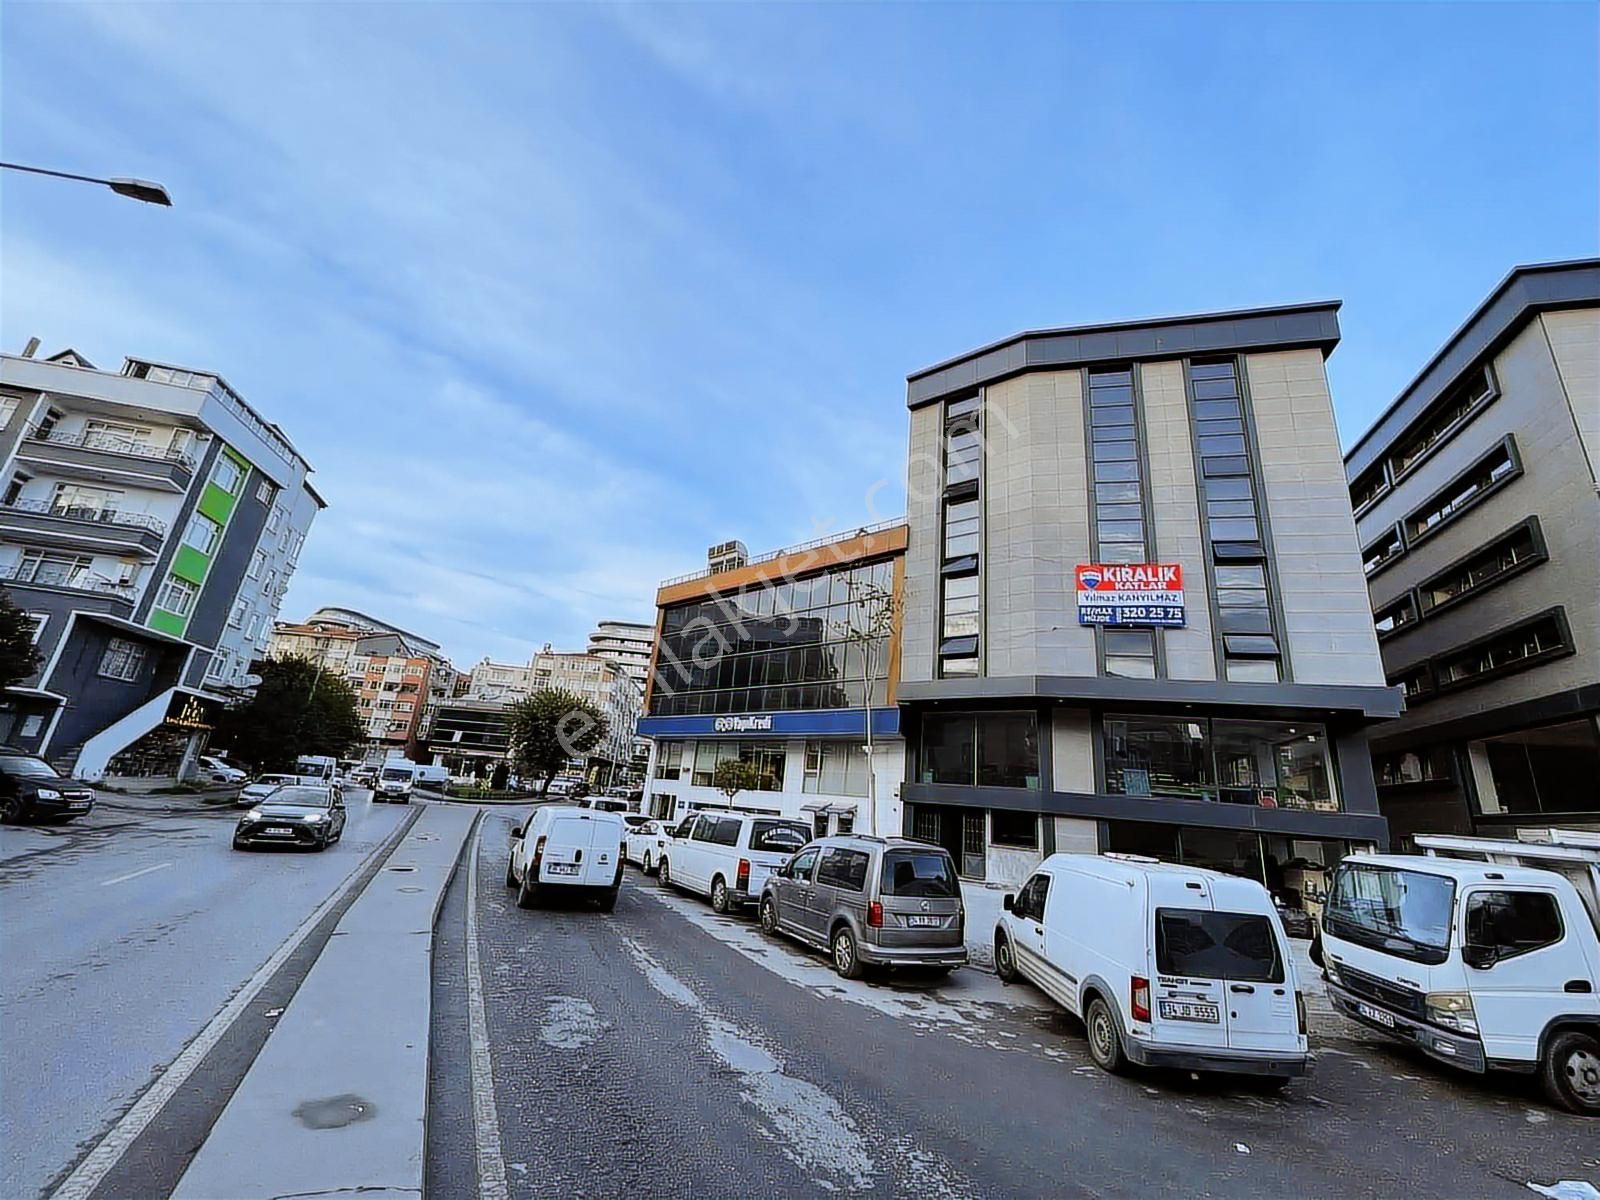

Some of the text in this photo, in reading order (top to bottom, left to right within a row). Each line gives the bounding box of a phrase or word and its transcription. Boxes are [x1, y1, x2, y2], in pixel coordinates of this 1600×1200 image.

[1115, 582, 1167, 590] KATLAR
[1123, 607, 1146, 618] 320
[1149, 607, 1164, 618] 25
[1167, 608, 1182, 618] 75
[1167, 1003, 1178, 1015] 34
